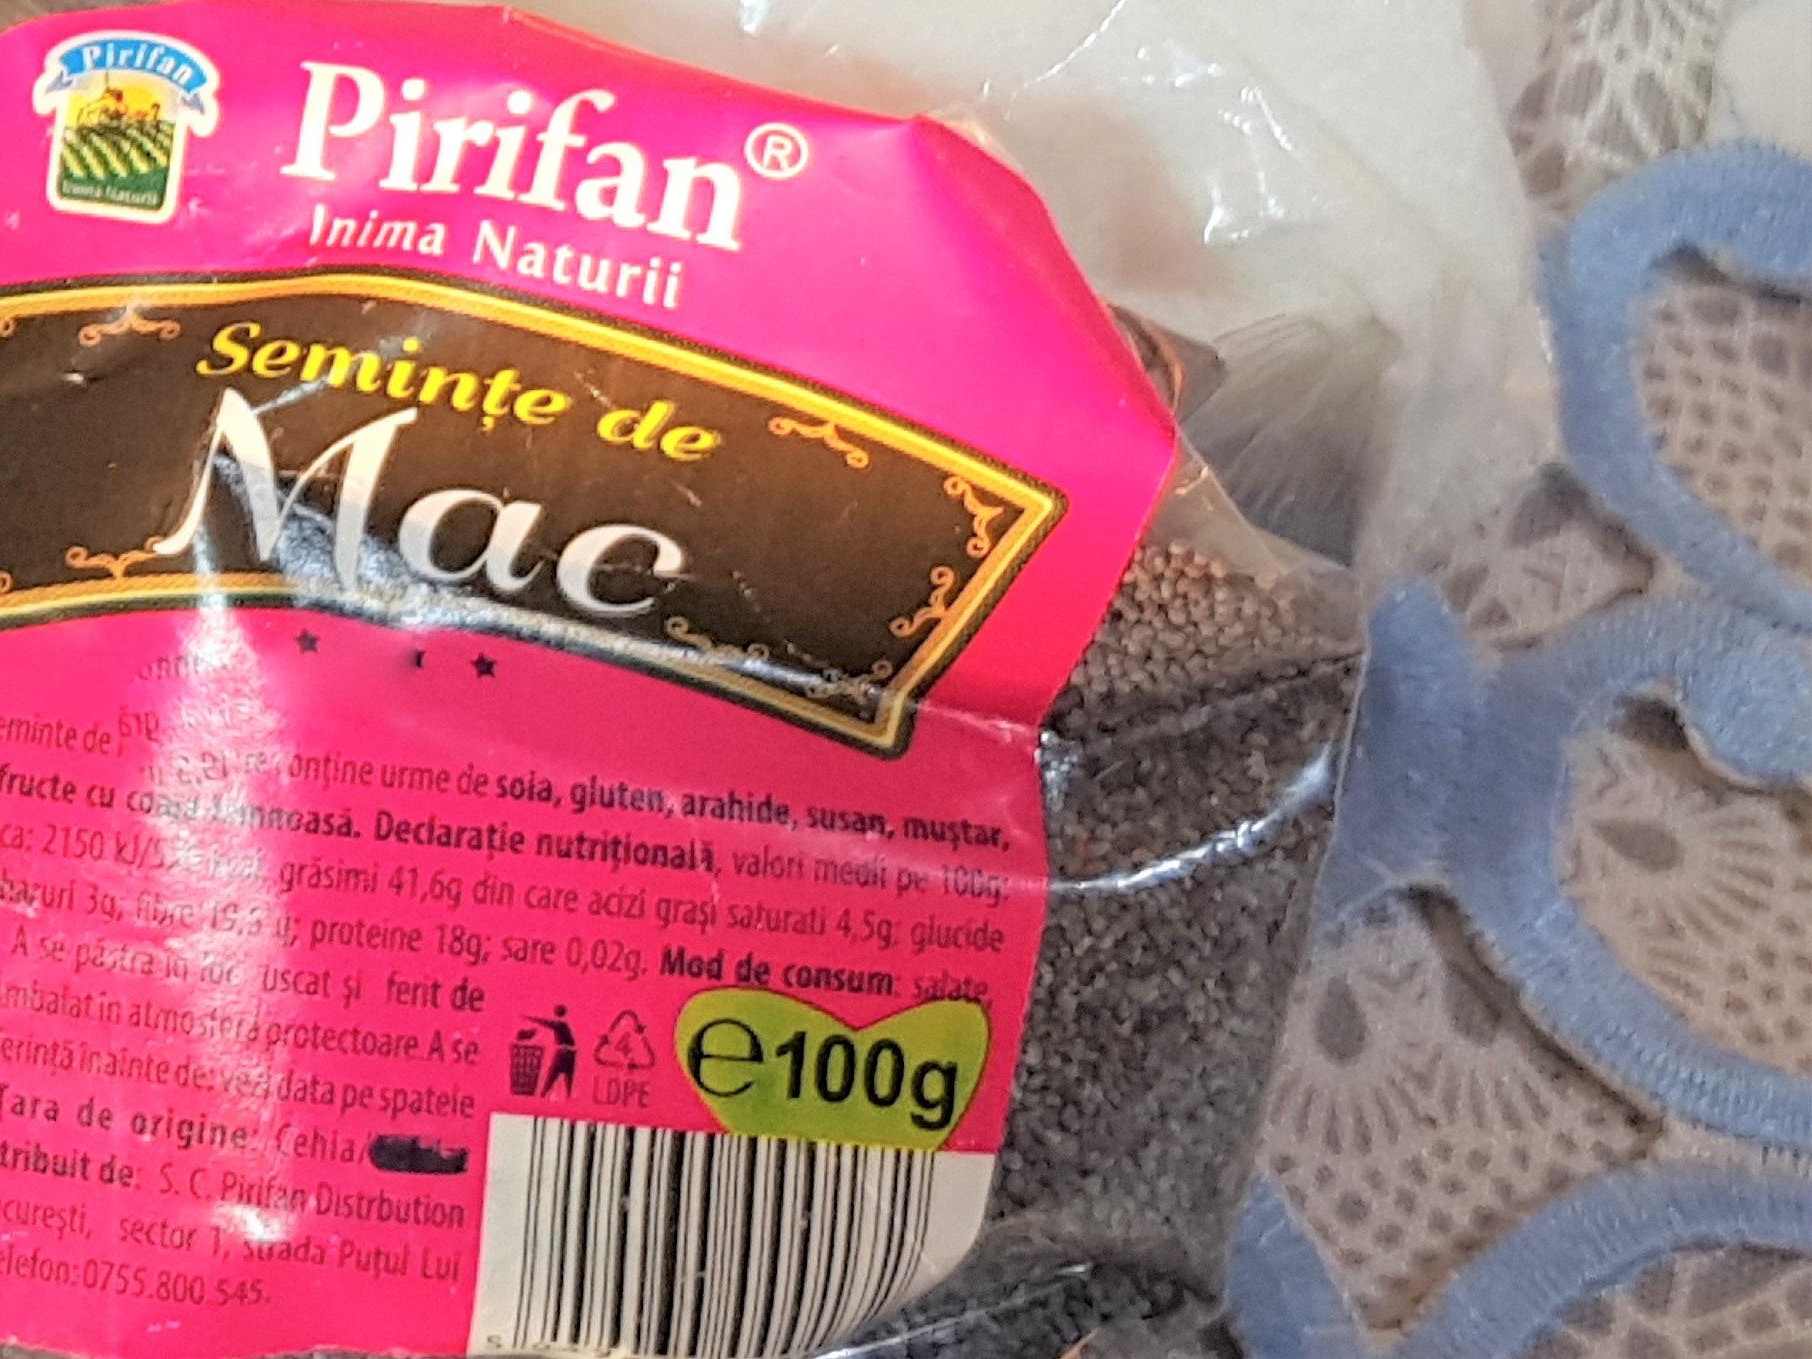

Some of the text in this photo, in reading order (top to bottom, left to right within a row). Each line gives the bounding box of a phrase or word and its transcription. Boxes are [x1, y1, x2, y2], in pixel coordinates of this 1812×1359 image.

[82, 41, 194, 85] Pirifan
[310, 203, 682, 308] Inima Naturii
[196, 322, 720, 461] Semințe de
[153, 387, 688, 618] Mac
[83, 727, 111, 755] de
[379, 763, 450, 794] urme
[456, 763, 490, 796] de
[495, 769, 563, 809] soia,
[569, 773, 675, 820] gluten,
[681, 787, 799, 831] arahide,
[805, 805, 896, 840] susan,
[42, 825, 104, 861] 2150
[85, 785, 116, 810] cu
[373, 809, 526, 862] Declarație
[533, 829, 723, 879] nutrițională,
[731, 843, 804, 880] valori
[813, 855, 887, 890] medii
[895, 869, 927, 899] pe
[278, 856, 378, 894] grăsimi
[388, 864, 463, 908] 41,6g
[472, 870, 515, 906] din
[523, 885, 580, 913] care
[588, 885, 646, 920] acizi
[655, 895, 717, 936] grași
[909, 913, 1005, 956] glucide
[10, 924, 28, 956] A
[39, 936, 65, 962] se
[261, 964, 330, 997] uscat
[342, 974, 362, 1010] și
[385, 970, 442, 1009] ferit
[449, 975, 486, 1013] de
[309, 917, 423, 953] proteine
[434, 922, 492, 967] 18g;
[500, 935, 556, 966] sare
[565, 934, 649, 982] 0,02g.
[659, 944, 725, 981] Mod
[735, 949, 772, 984] de
[782, 962, 902, 998] consum:
[266, 1021, 419, 1060] protectoare
[427, 1029, 445, 1059] A
[451, 1039, 479, 1065] se
[174, 1060, 214, 1091] de:
[277, 1068, 336, 1106] data
[340, 1083, 373, 1116] pe
[377, 1083, 476, 1122] spatele
[592, 1077, 650, 1108] LDPE
[775, 1030, 960, 1131] 100g
[76, 1095, 114, 1130] de
[129, 1107, 258, 1151] origine:
[97, 1155, 139, 1188] de:
[159, 1162, 179, 1195] S.
[219, 1170, 306, 1213] Pirifan
[119, 1217, 197, 1251] sector
[337, 1239, 410, 1279] Puțul
[420, 1248, 461, 1282] Lui
